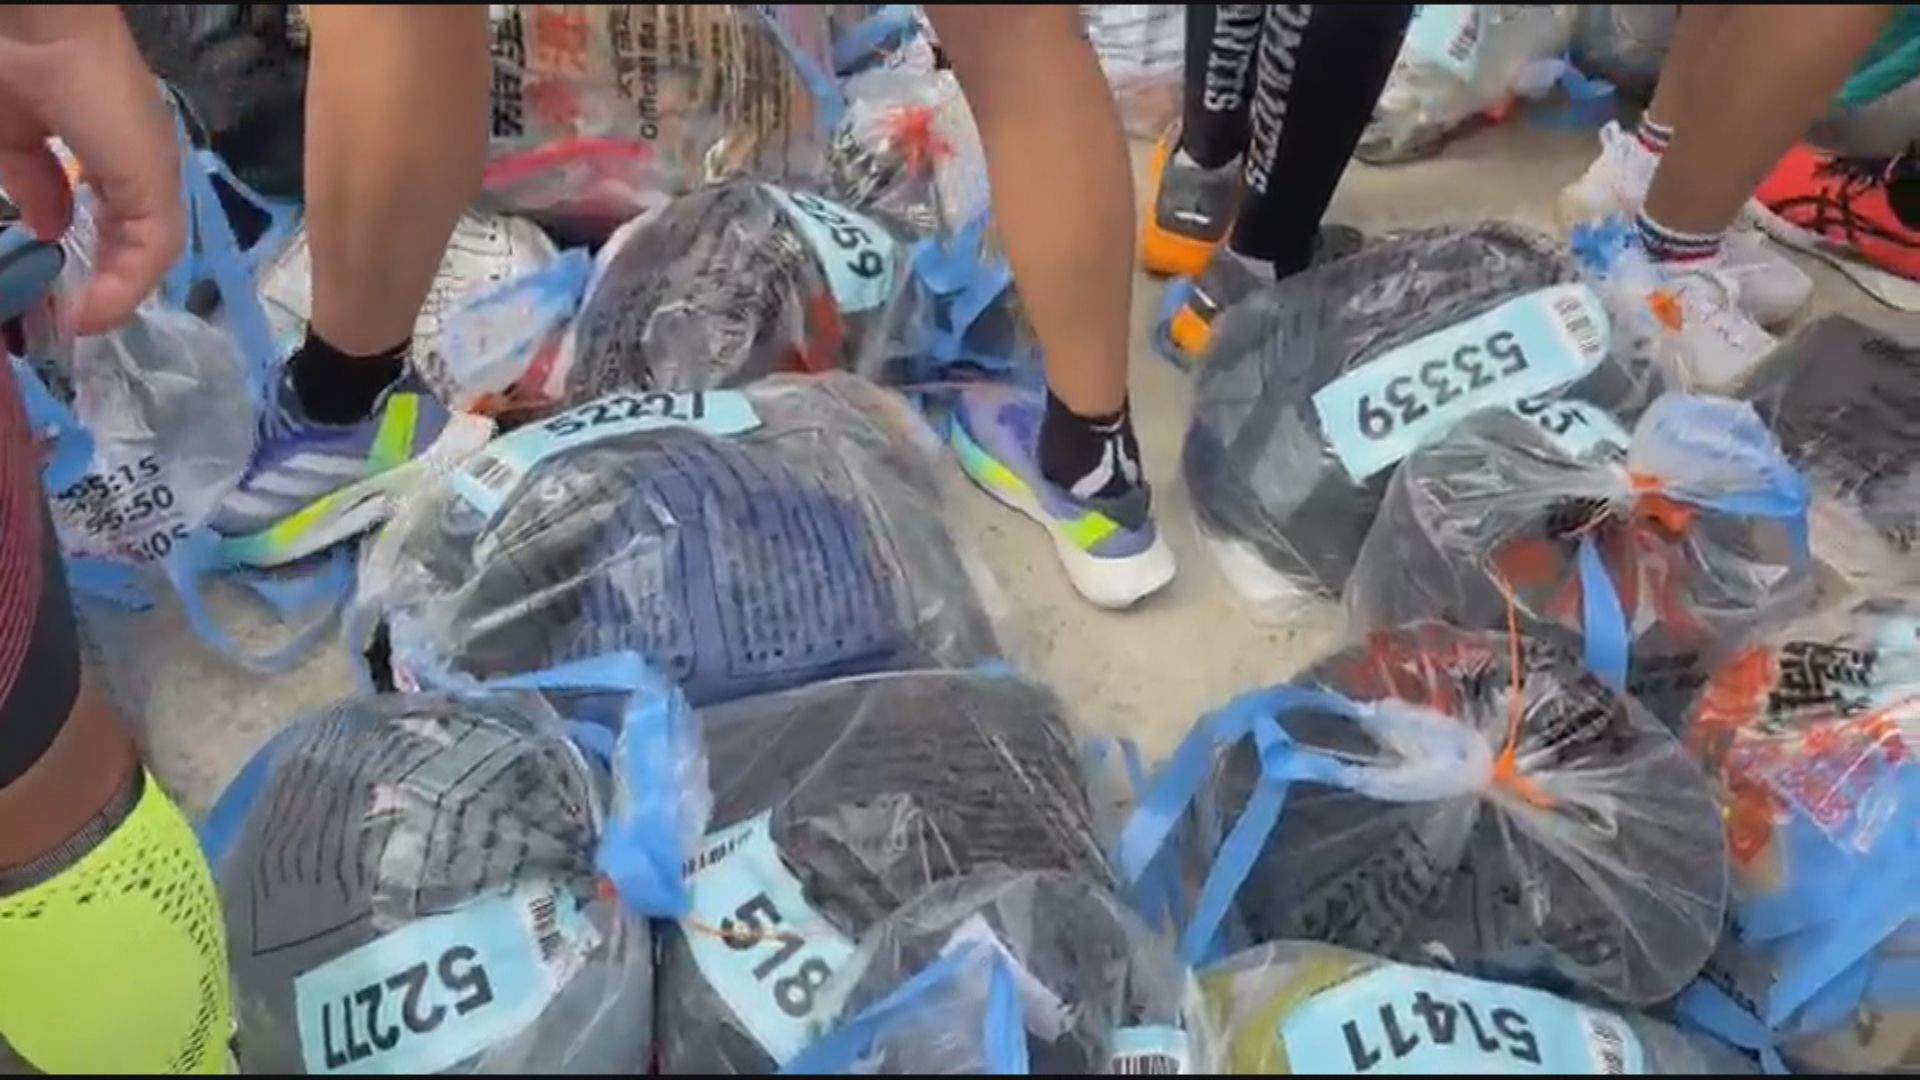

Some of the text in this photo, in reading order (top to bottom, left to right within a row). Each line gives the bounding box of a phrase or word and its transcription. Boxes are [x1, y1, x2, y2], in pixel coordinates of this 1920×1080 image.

[1357, 331, 1529, 440] 53339
[323, 946, 494, 1069] 52277
[1342, 992, 1542, 1072] 51411
